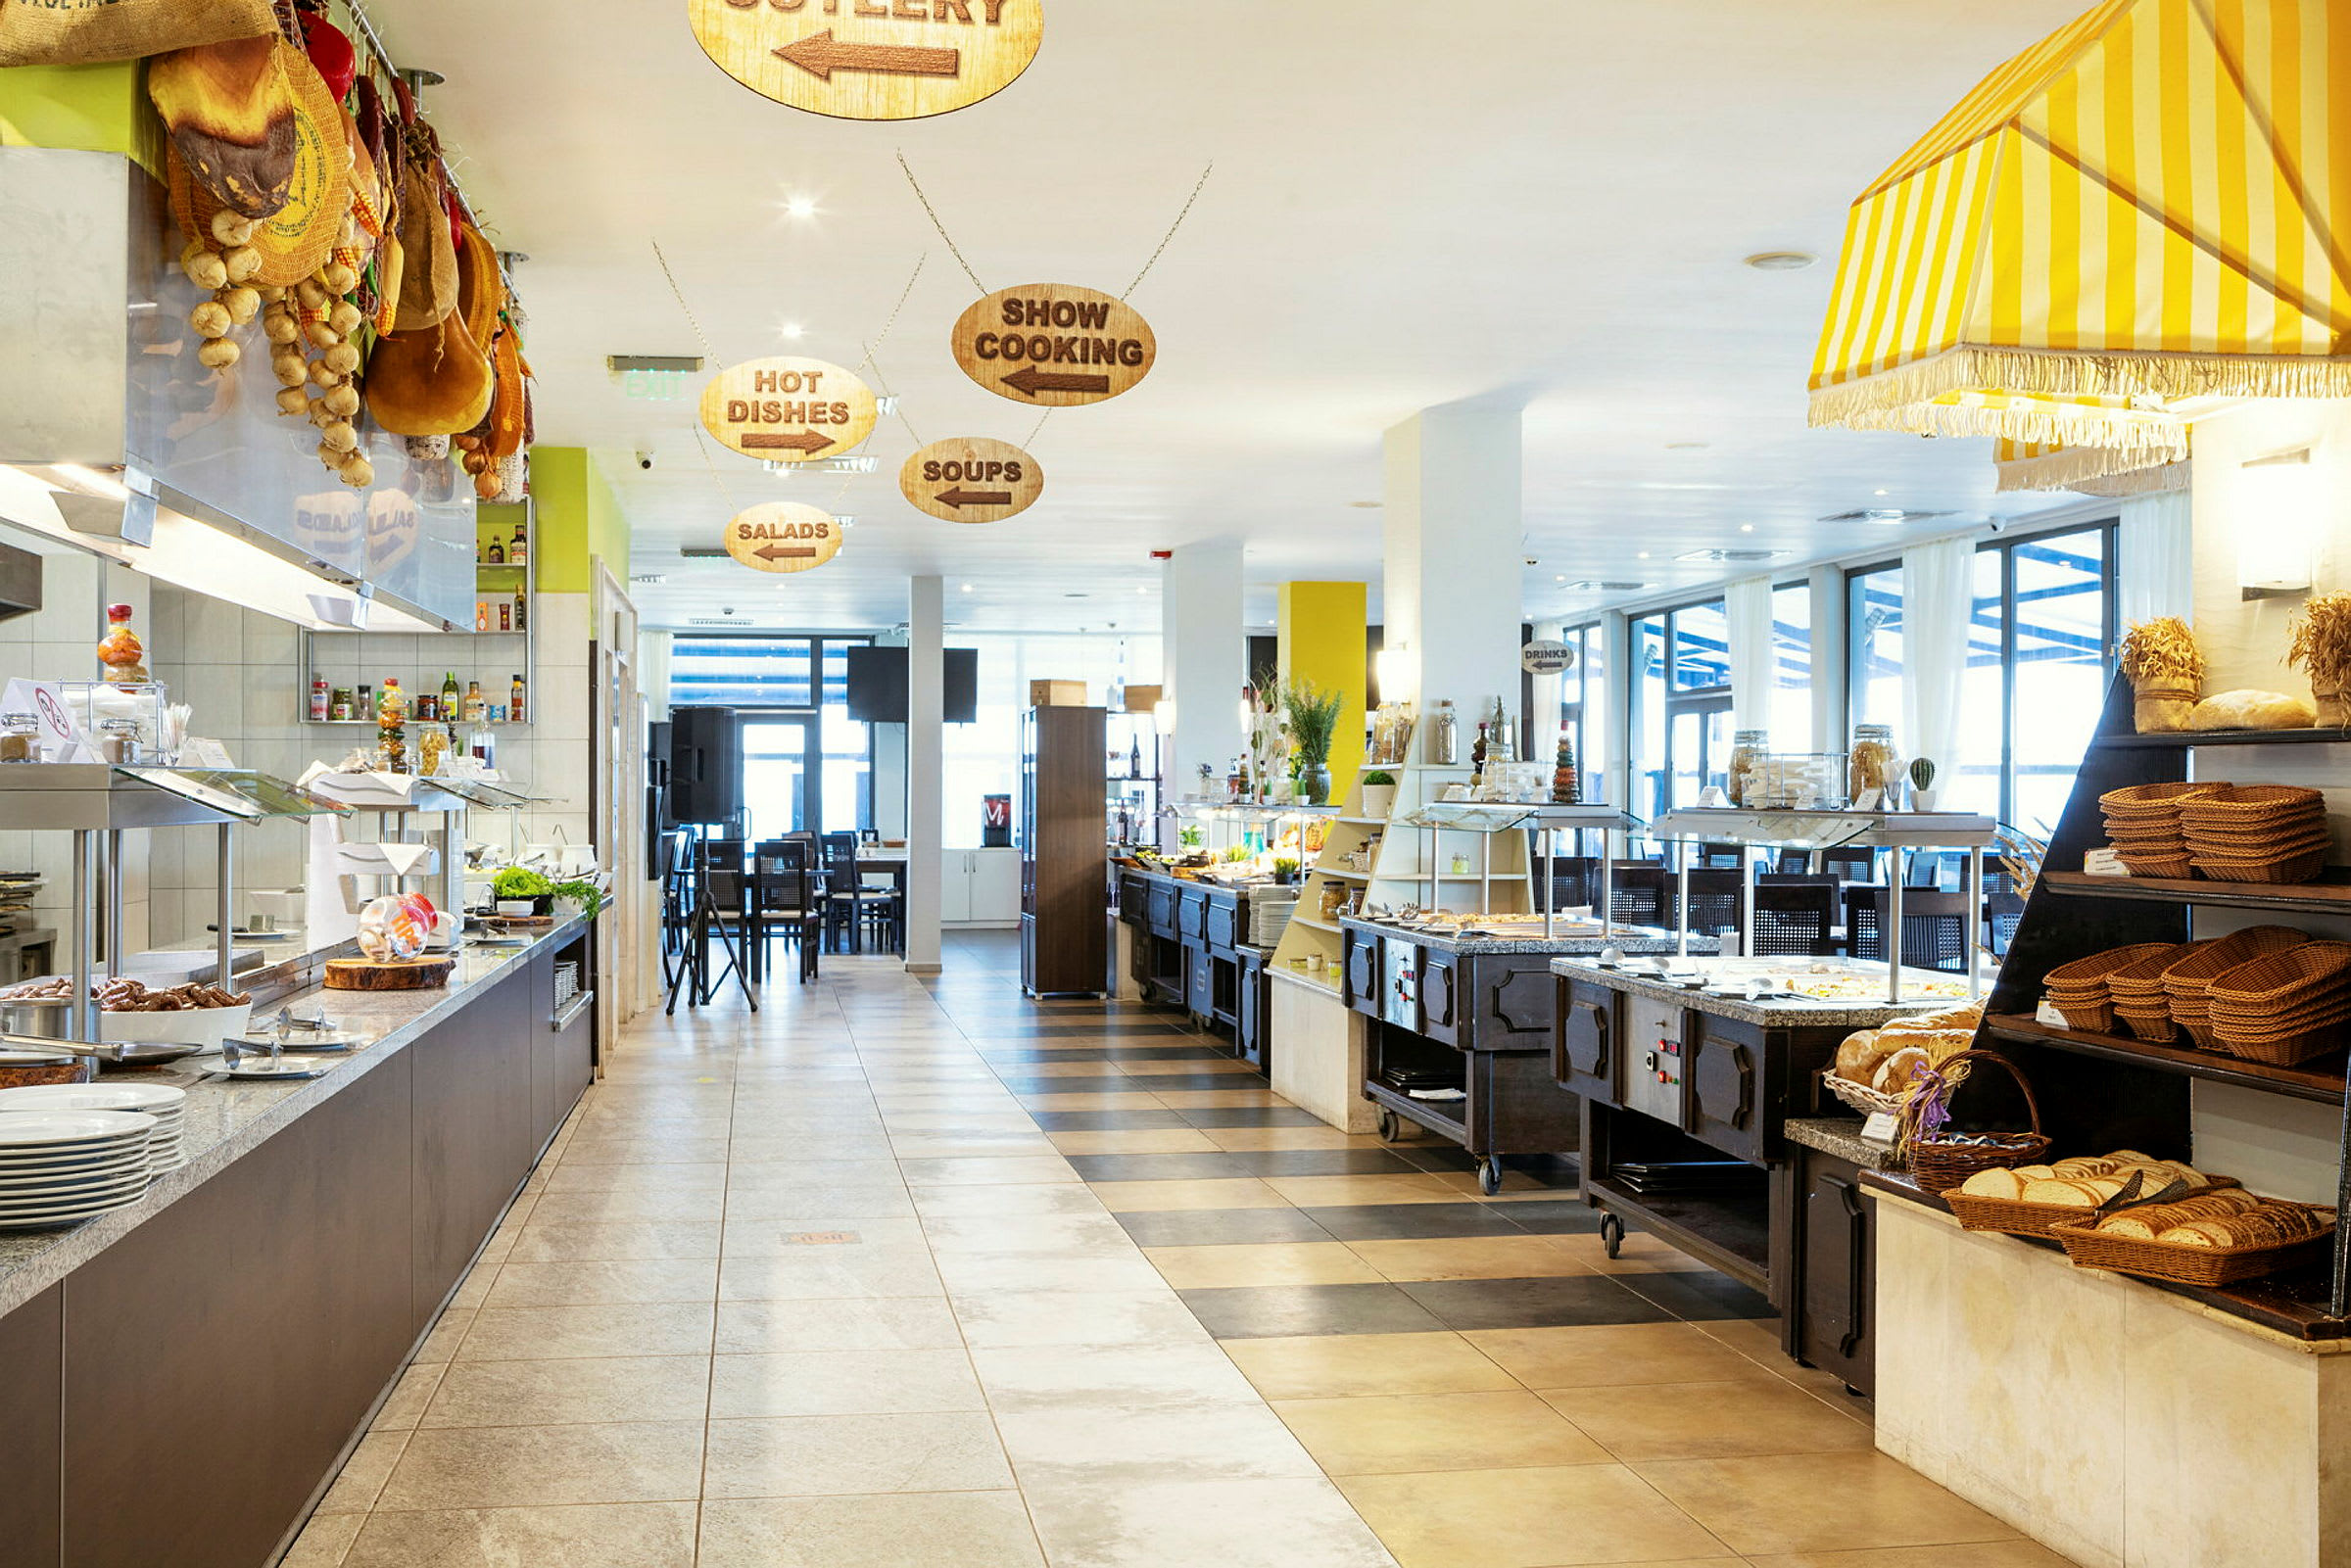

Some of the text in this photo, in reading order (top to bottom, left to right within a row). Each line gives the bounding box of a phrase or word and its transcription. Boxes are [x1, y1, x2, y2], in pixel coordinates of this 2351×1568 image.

[1002, 298, 1110, 329] SHOW
[975, 332, 1143, 366] COOKING
[754, 370, 823, 393] HOT
[728, 400, 849, 424] DISHES
[923, 460, 1022, 482] SOUPS
[739, 523, 829, 539] SALADS
[1525, 649, 1567, 659] DRINKS
